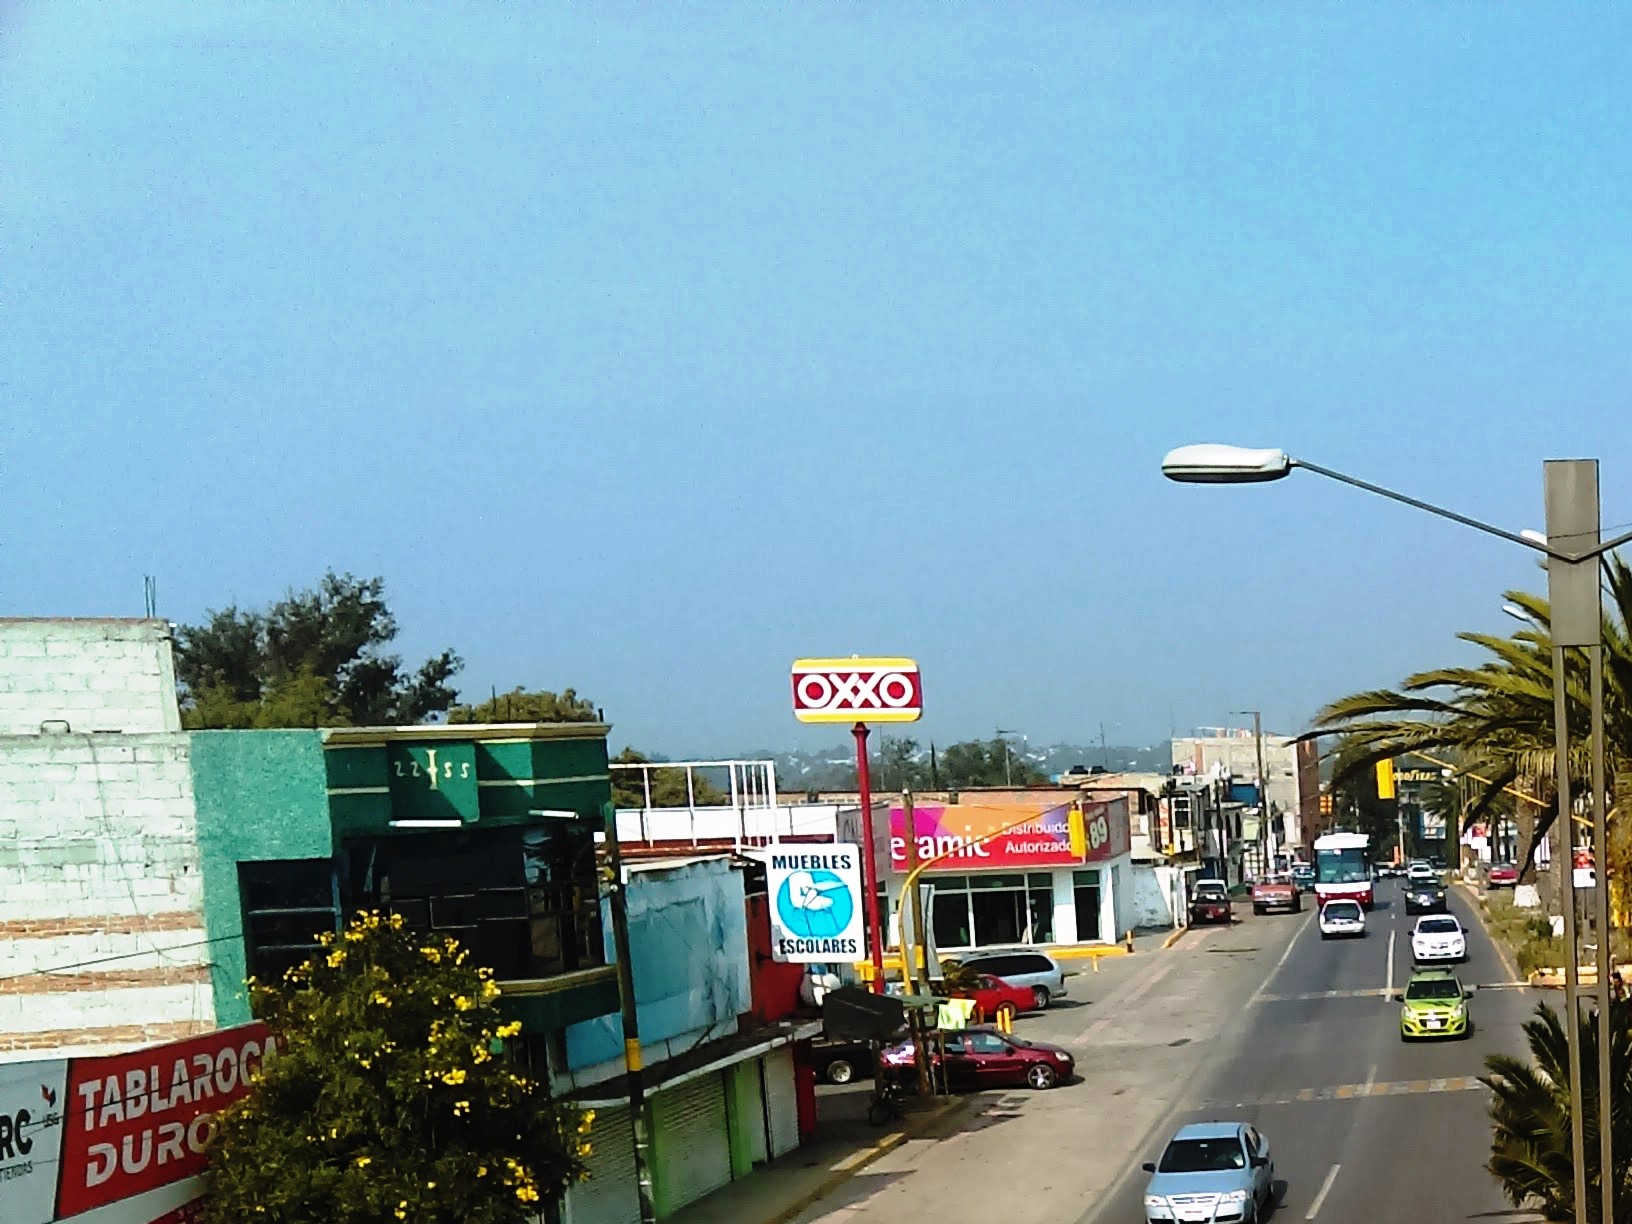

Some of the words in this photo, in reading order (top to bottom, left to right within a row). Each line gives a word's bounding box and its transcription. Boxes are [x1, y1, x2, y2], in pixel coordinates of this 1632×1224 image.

[798, 671, 914, 709] OXXO
[772, 854, 852, 870] MUEBLES
[778, 938, 857, 955] ESCOLARES
